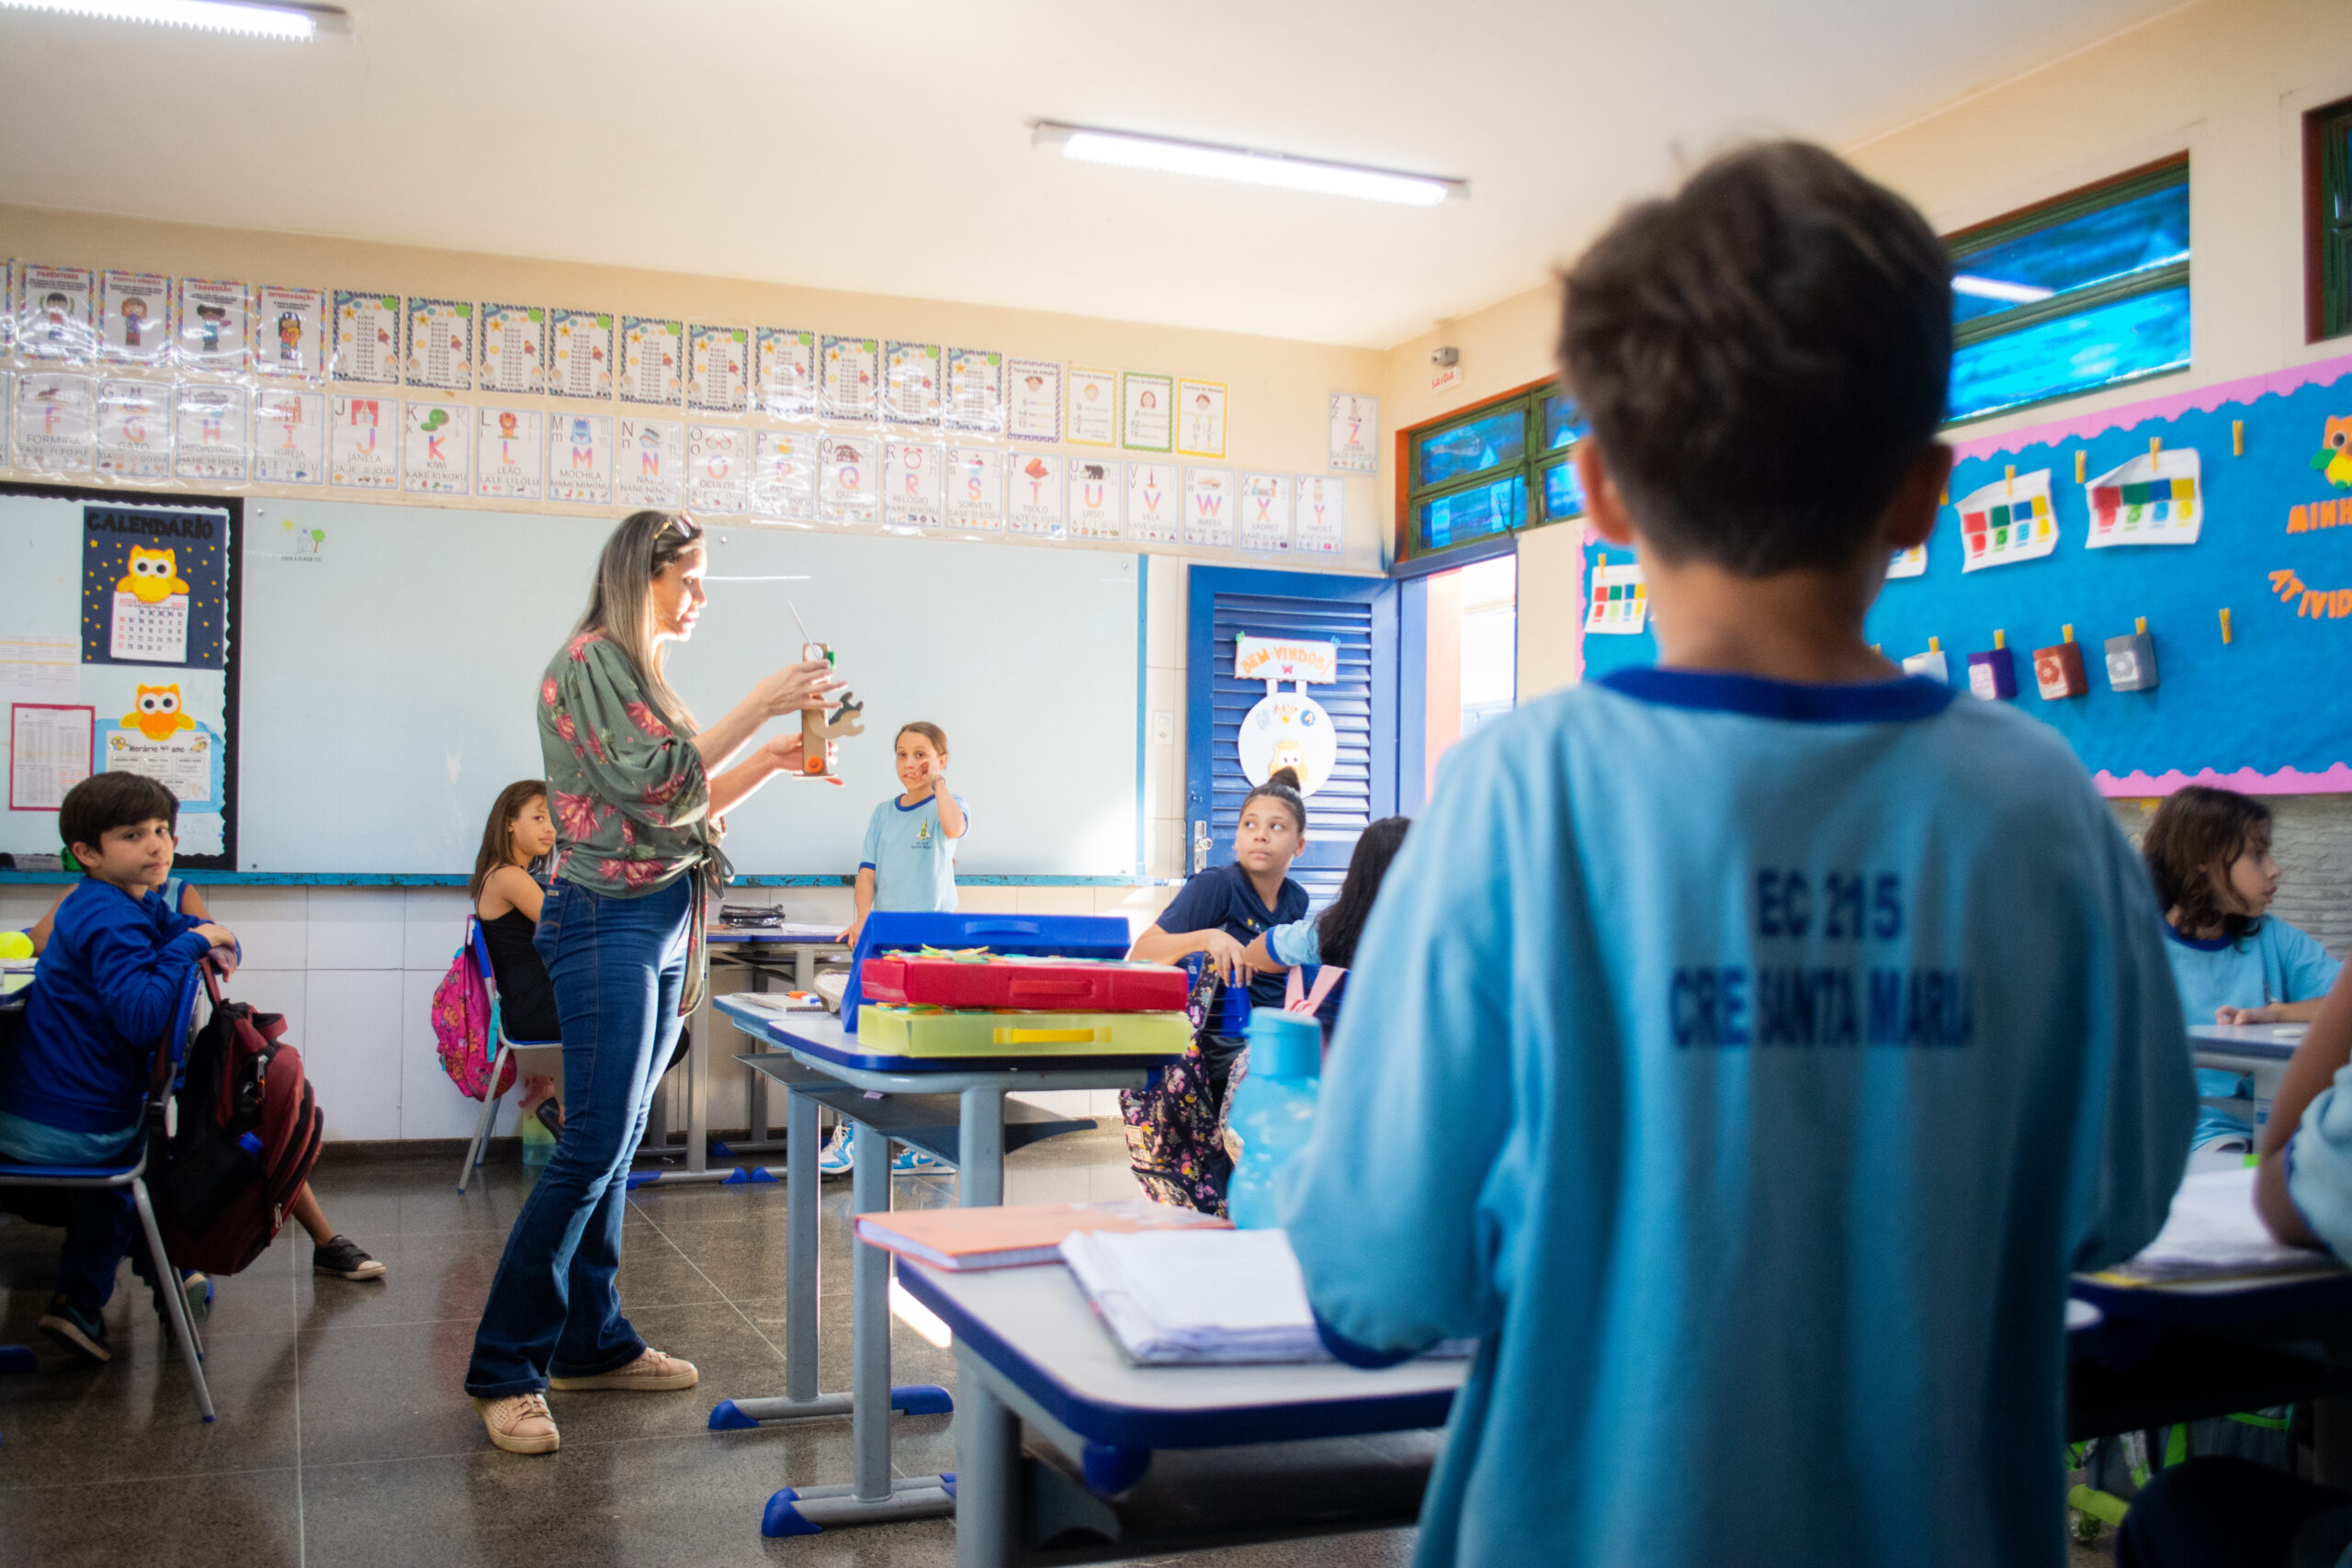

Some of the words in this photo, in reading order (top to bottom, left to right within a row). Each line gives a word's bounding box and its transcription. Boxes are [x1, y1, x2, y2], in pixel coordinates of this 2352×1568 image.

[334, 399, 345, 417] J
[1332, 395, 1340, 410] Z
[46, 404, 65, 434] F
[407, 404, 418, 422] K
[481, 410, 492, 427] L
[123, 416, 146, 443] G
[202, 419, 220, 445] H
[551, 415, 563, 431] M
[622, 421, 634, 438] N
[283, 424, 298, 449] I
[356, 427, 376, 455] J
[551, 432, 563, 442] m
[690, 427, 703, 442] O
[758, 433, 767, 446] P
[1349, 423, 1361, 445] Z
[428, 434, 446, 461] K
[503, 439, 515, 465] L
[622, 439, 630, 449] n
[822, 438, 833, 455] Q
[887, 445, 897, 460] R
[274, 449, 306, 460] IGREJA
[347, 454, 382, 464] JANELA
[572, 446, 593, 470] M
[949, 449, 959, 464] S
[1011, 455, 1020, 468] T
[426, 461, 447, 469] KIWI
[497, 466, 522, 476] LEÃO
[641, 451, 659, 477] N
[707, 455, 729, 479] O
[1070, 459, 1079, 472] U
[1130, 464, 1138, 479] V
[560, 469, 602, 479] MOCHILA
[839, 466, 860, 491] Q
[906, 473, 920, 496] R
[967, 477, 982, 501] S
[1029, 480, 1043, 506] T
[893, 494, 929, 504] RELÓGIO
[1085, 483, 1102, 509] U
[1143, 491, 1161, 513] V
[957, 501, 992, 511] SORVETE
[1023, 504, 1048, 514] TIJOLO
[1196, 493, 1222, 518] W
[1257, 497, 1271, 523] X
[1314, 503, 1326, 525] Y
[1082, 511, 1104, 519] URSO
[1142, 513, 1160, 522] VELA
[86, 513, 214, 540] CALENDÁRIO
[1758, 868, 1810, 938] EC
[1825, 870, 1903, 940] 215
[1668, 967, 1749, 1048] CRE
